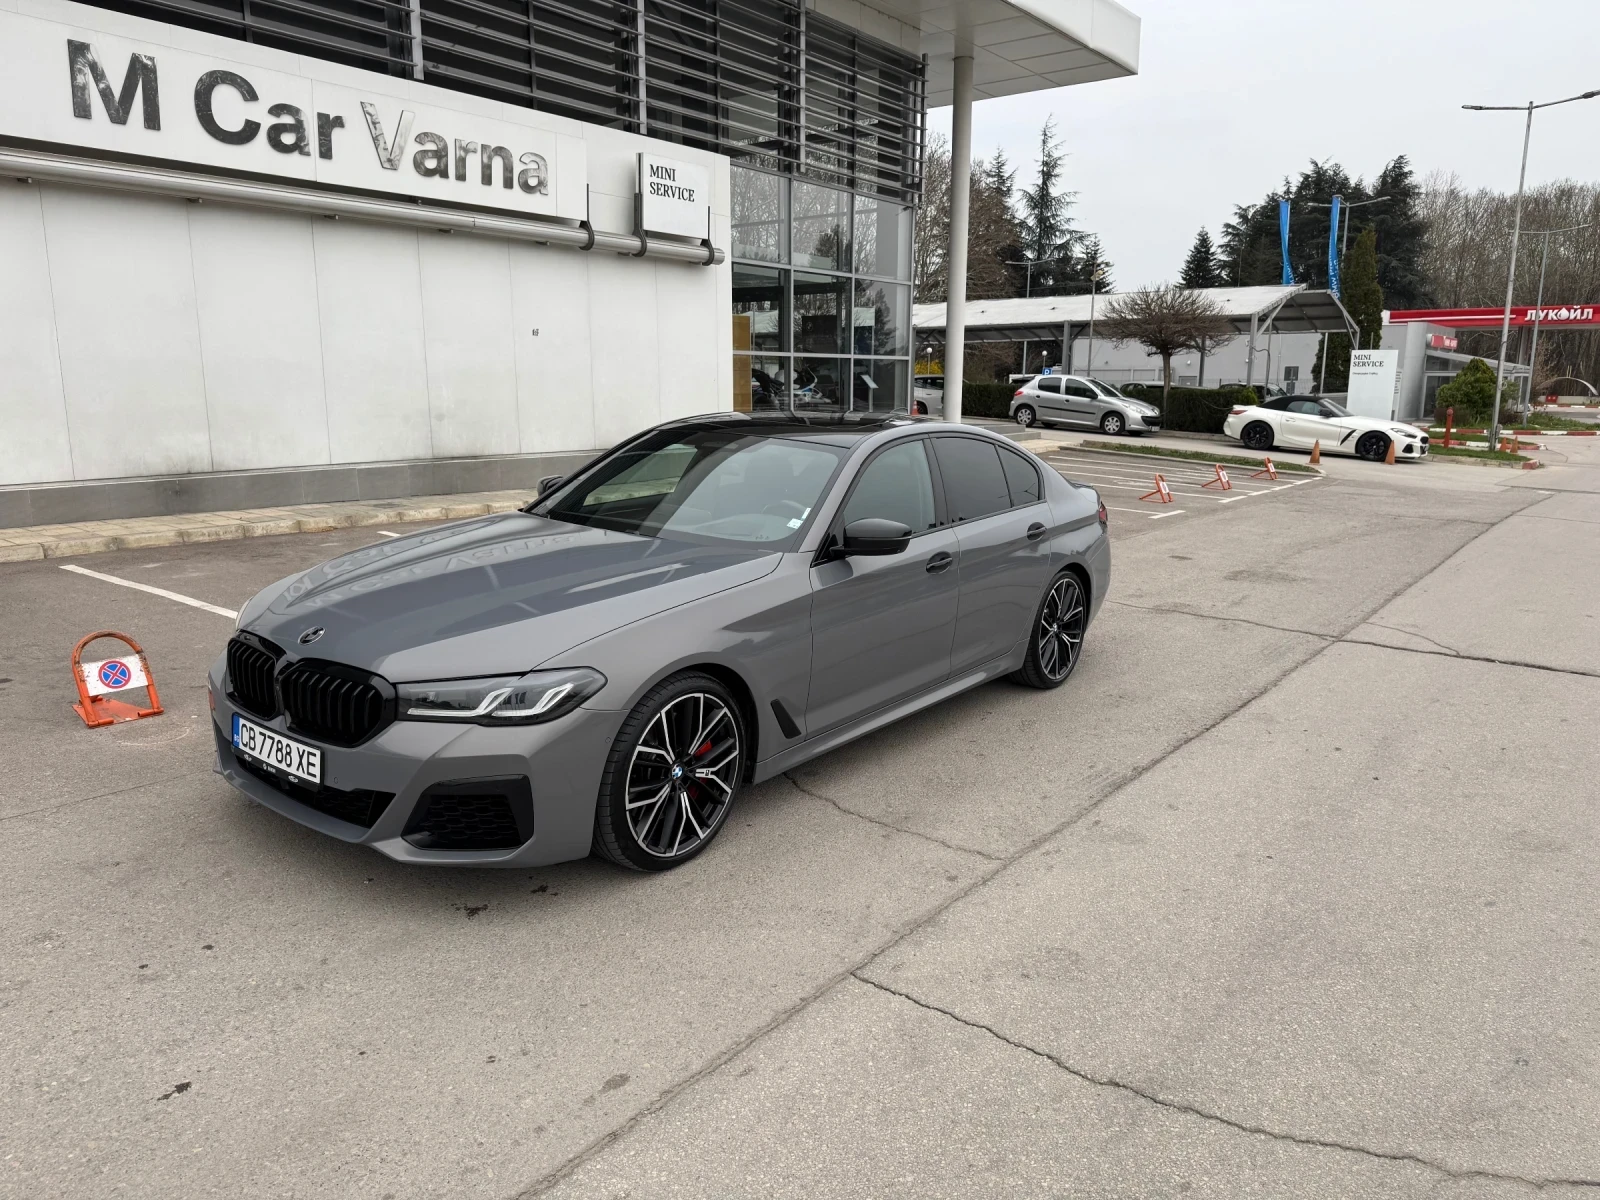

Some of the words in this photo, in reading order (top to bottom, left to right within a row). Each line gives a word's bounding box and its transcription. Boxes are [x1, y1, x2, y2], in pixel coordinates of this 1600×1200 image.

[67, 39, 161, 131] M
[194, 69, 345, 161] Car
[360, 101, 549, 196] Varna
[649, 164, 676, 182] MINI
[649, 181, 695, 202] SERVICE
[241, 723, 256, 752] CB
[258, 731, 293, 768] 7788
[296, 746, 317, 779] XE
